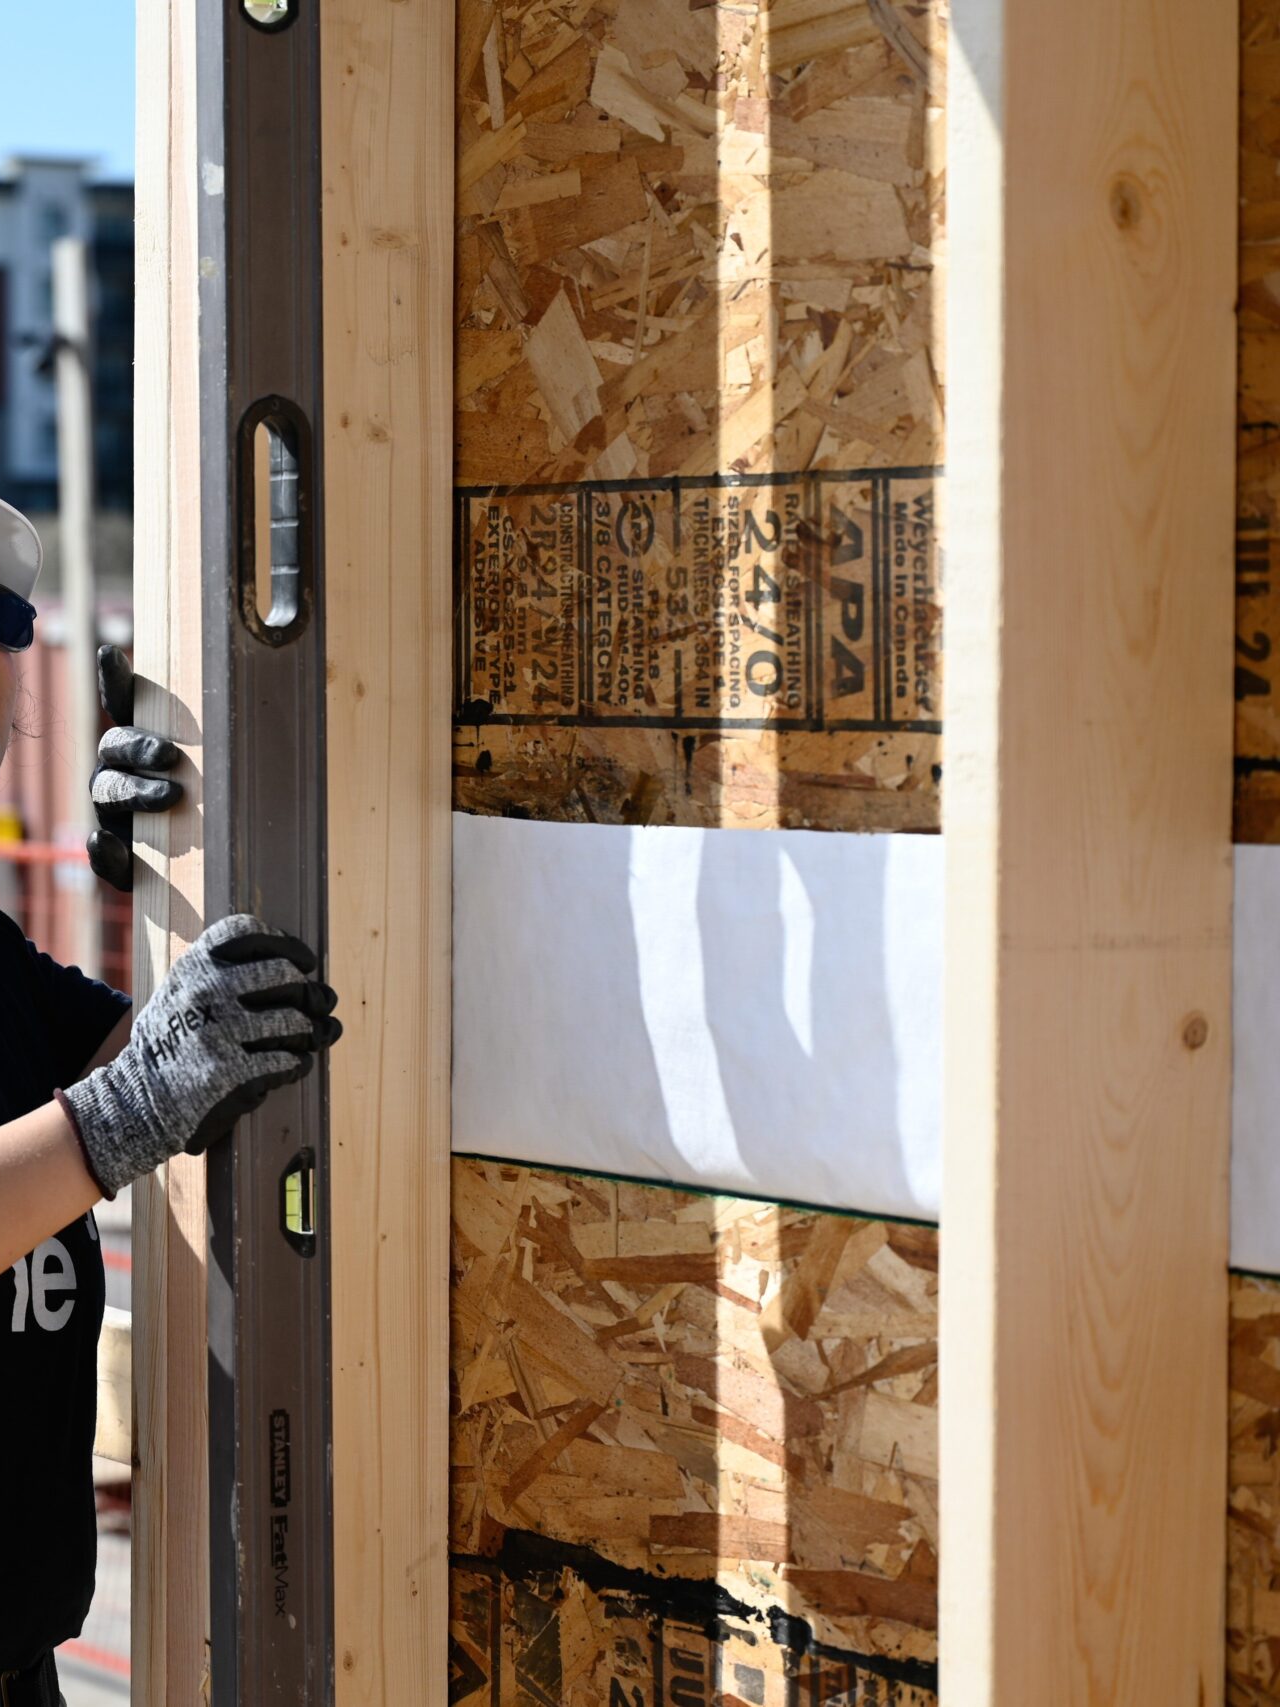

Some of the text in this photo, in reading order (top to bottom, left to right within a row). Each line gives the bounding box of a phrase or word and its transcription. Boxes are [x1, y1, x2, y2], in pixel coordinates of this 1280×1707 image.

[693, 497, 710, 616] THICKNESS
[711, 517, 726, 665] EXPOSURE
[728, 495, 741, 709] SIZED FOR SPACING
[830, 502, 864, 700] APA
[894, 502, 909, 567] Made
[475, 538, 486, 672] ADHESIVE
[488, 505, 502, 706] EXTERIOR TYPE
[517, 606, 527, 655] mm
[560, 503, 575, 707] CONSTRUCTION SHEATHING
[595, 501, 612, 707] 3/8 CATEGORY
[632, 568, 644, 700] SHEATHING
[741, 509, 784, 698] 24/0
[786, 575, 802, 710] SHEATHING
[895, 605, 909, 699] Canada
[695, 687, 710, 709] IN
[149, 1003, 218, 1070] HyFlex
[273, 1415, 289, 1617] STANLEY FatMax
